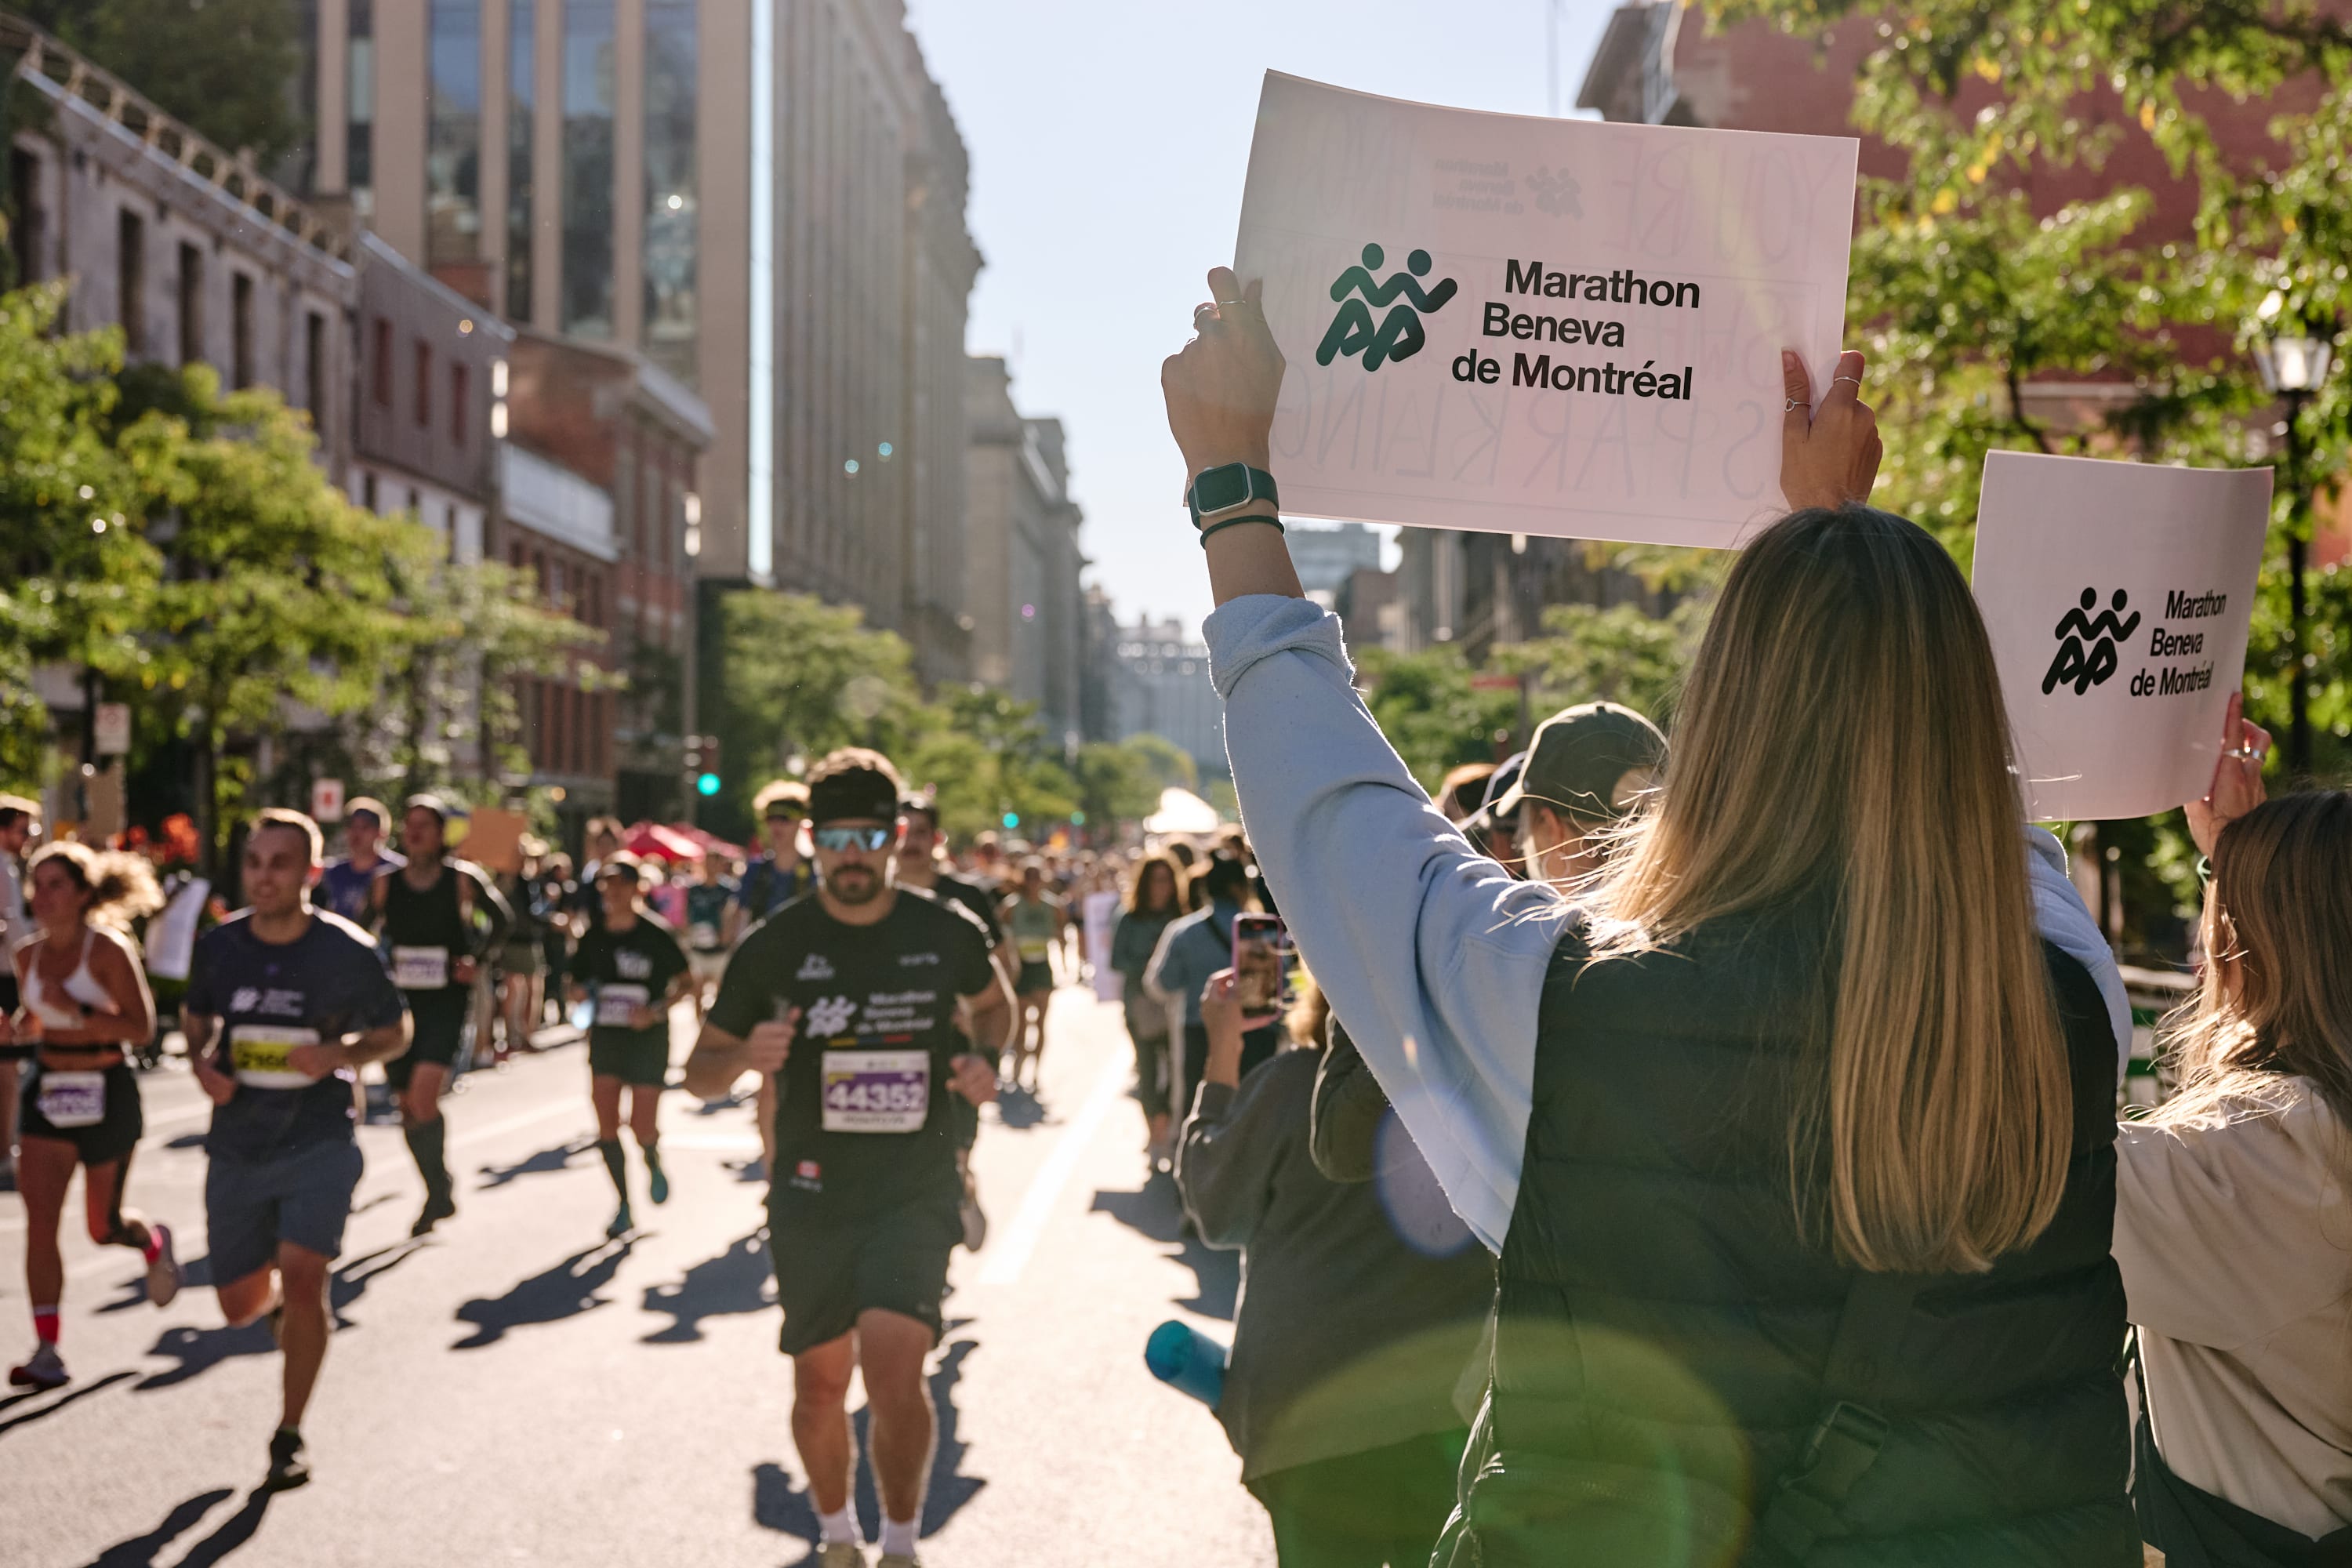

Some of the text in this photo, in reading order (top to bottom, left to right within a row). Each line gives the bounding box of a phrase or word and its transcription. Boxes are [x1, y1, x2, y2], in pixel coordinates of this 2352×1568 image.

[1505, 260, 1700, 308] Marathon
[1483, 302, 1624, 348] Beneva
[1452, 349, 1693, 401] de Montréal
[2165, 590, 2227, 619] Marathon
[2150, 628, 2204, 657] Beneva
[2130, 660, 2214, 696] de Montréal
[828, 1082, 925, 1112] 44352
